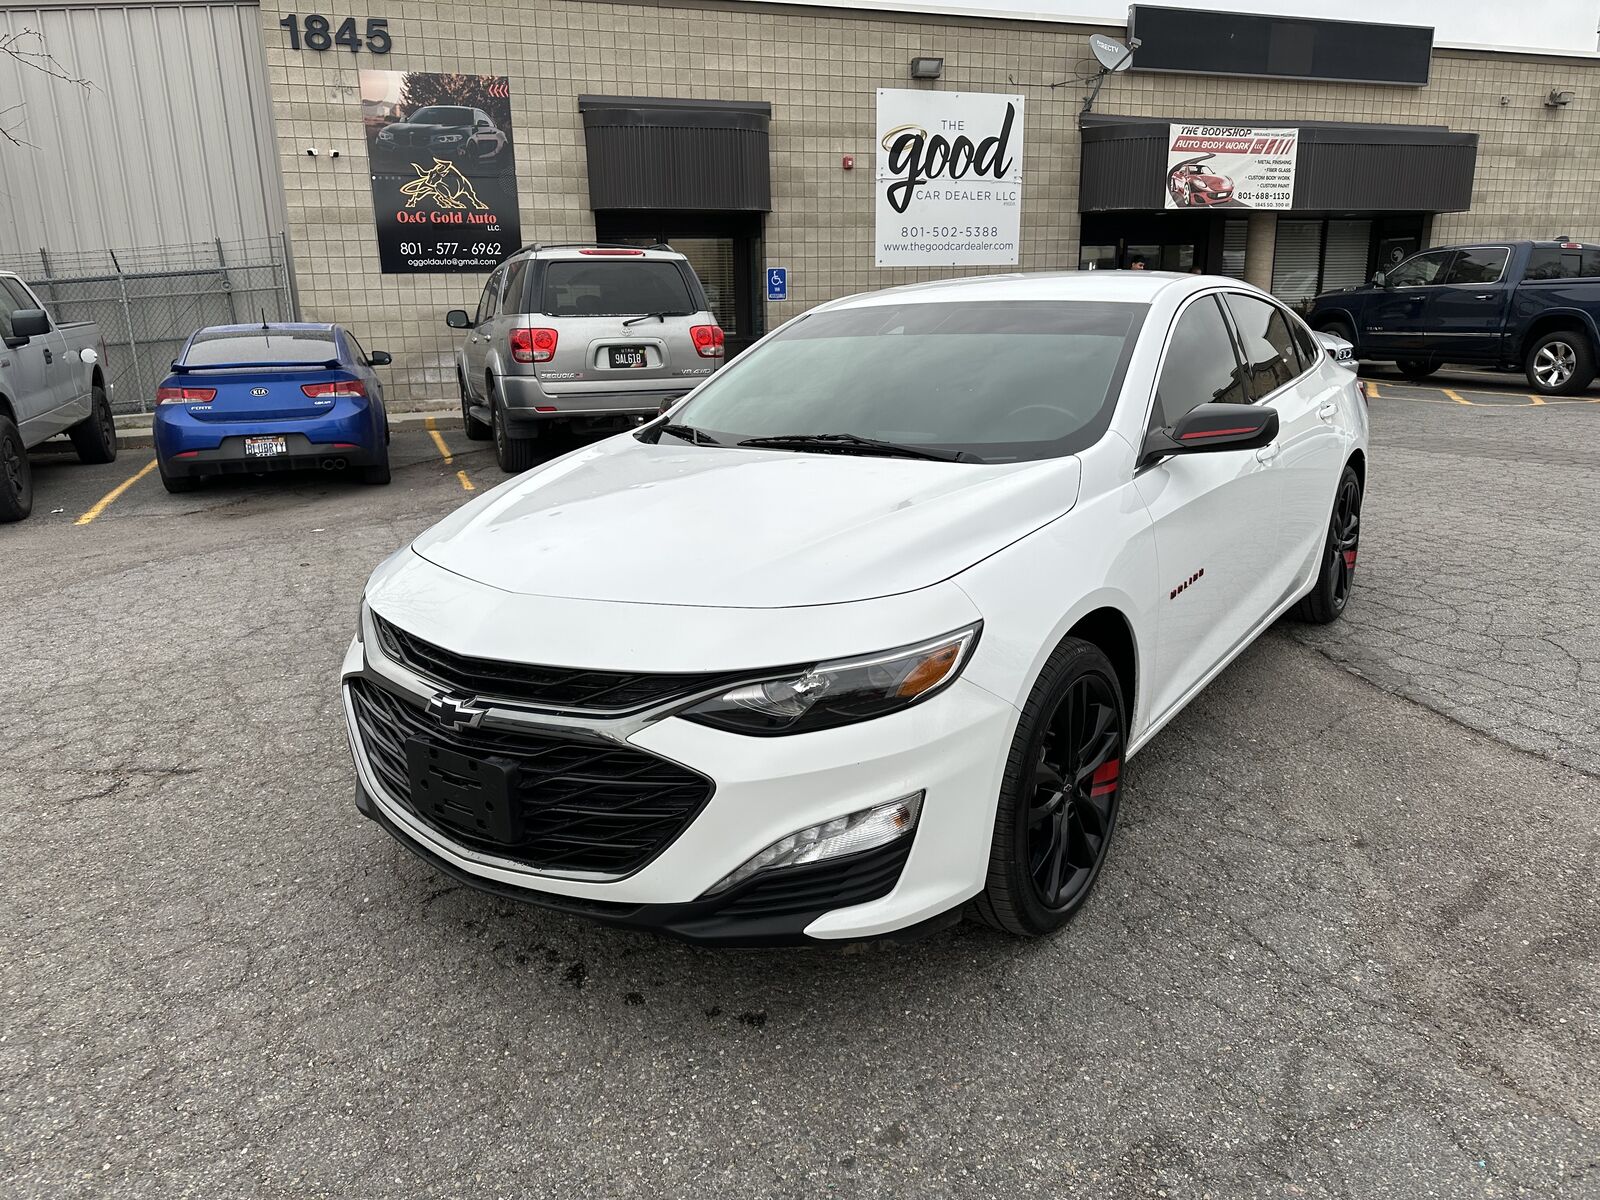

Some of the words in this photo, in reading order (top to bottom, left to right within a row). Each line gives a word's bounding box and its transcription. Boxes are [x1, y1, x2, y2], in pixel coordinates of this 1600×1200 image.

[280, 13, 392, 55] 1845
[941, 119, 965, 131] THE
[1181, 126, 1200, 136] THE
[1201, 127, 1252, 137] BODYSHOP
[1176, 140, 1200, 149] AUTO
[1201, 141, 1225, 149] BODY
[1225, 141, 1251, 150] WORK
[886, 101, 1016, 214] good
[916, 190, 940, 201] CAR
[945, 191, 992, 201] DEALER
[996, 192, 1016, 201] LLC
[1237, 191, 1291, 200] 801-688-1130
[396, 210, 426, 224] O&G
[430, 211, 463, 224] Gold
[466, 211, 497, 224] Auto
[901, 226, 998, 238] 801-502-5388
[400, 242, 422, 255] 801
[435, 242, 459, 255] 577
[471, 242, 502, 255] 6962
[883, 241, 1014, 252] www.thegoodcardealer.com
[407, 258, 497, 267] oggoldauto@gmail.com
[614, 355, 642, 365] 9AL618
[1170, 568, 1204, 600] MALIBU
